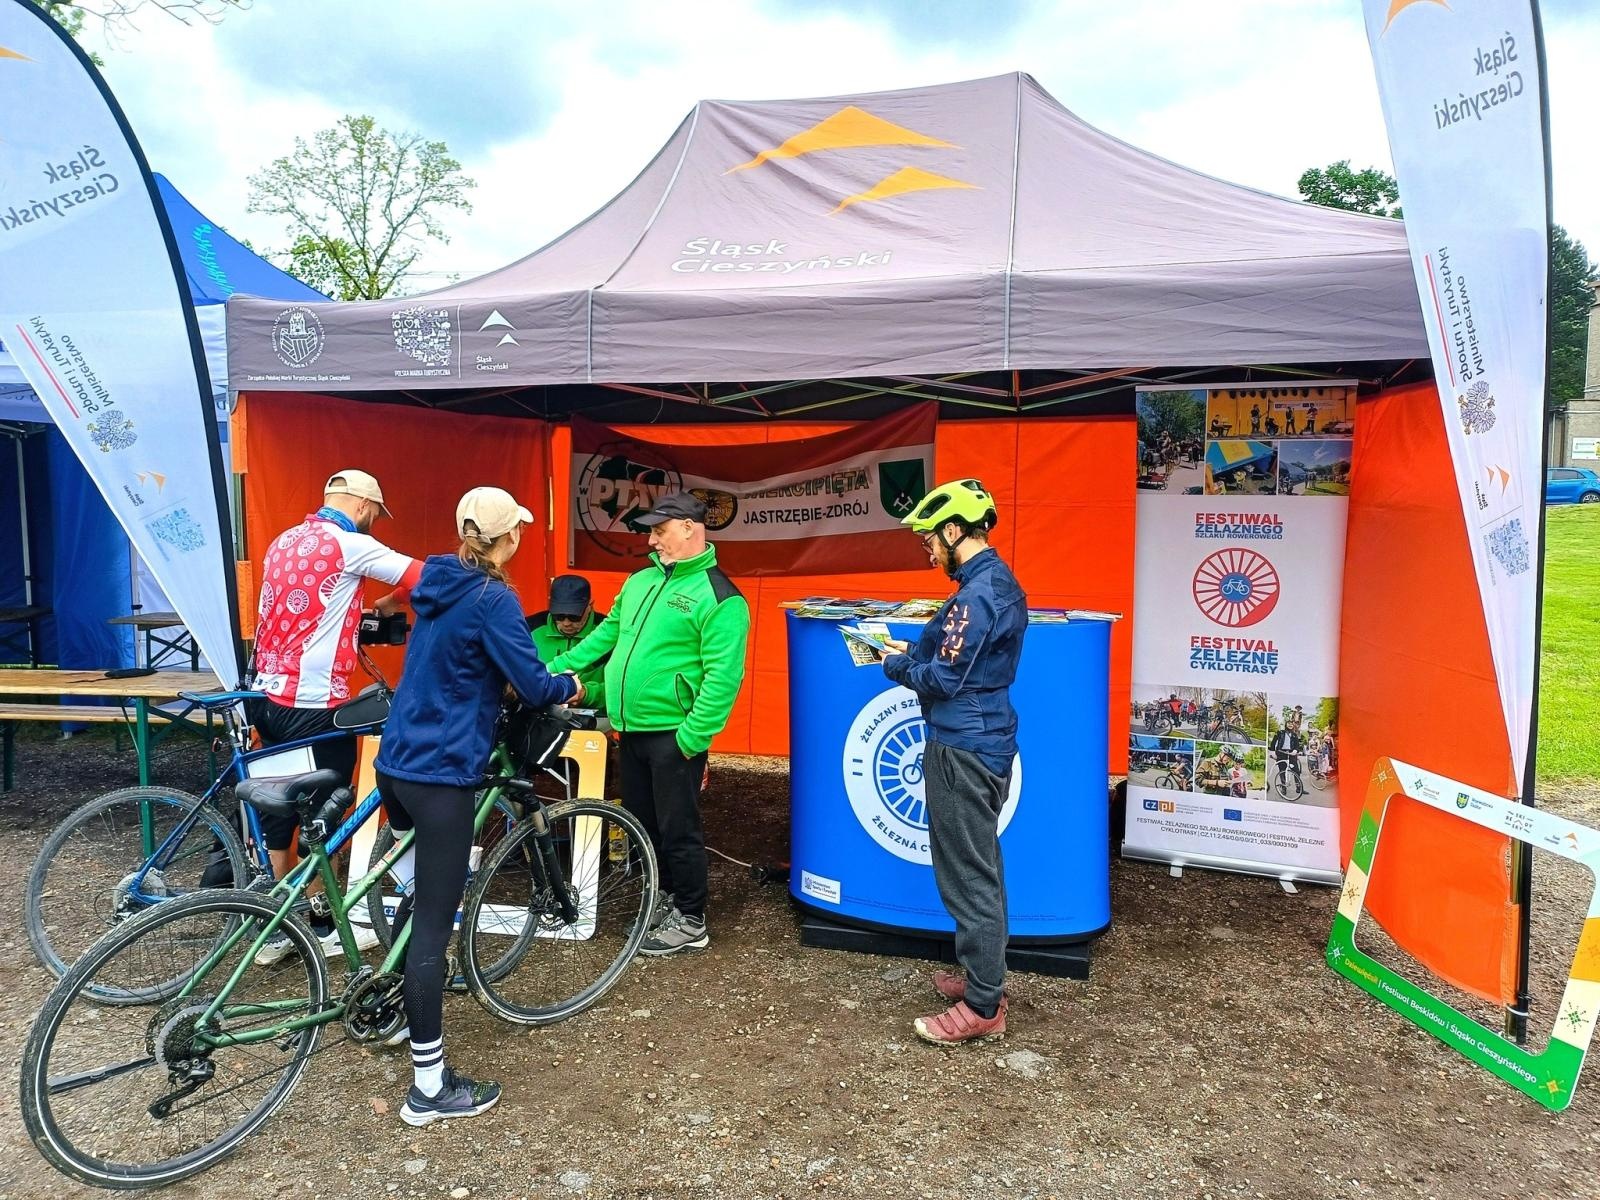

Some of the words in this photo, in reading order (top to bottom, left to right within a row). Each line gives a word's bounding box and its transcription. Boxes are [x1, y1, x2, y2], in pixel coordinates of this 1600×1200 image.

[681, 237, 788, 259] Śląsk
[671, 250, 892, 274] Cieszyński
[476, 355, 493, 363] Śląsk
[743, 499, 869, 525] JASTRZĘBIE-ZDRÓJ
[1195, 513, 1283, 525] FESTIWAL
[1190, 636, 1278, 652] FESTIVAL
[1190, 660, 1278, 674] CYKLOTRASY
[860, 704, 898, 744] ŻELAZNY
[872, 815, 917, 850] ŽELEZNÁ
[1137, 817, 1164, 825] FESTIWAL
[1221, 828, 1266, 838] ROWEROWEGO
[1269, 834, 1296, 842] FESTIVAL
[1160, 826, 1197, 836] CYKLOTRASY
[1381, 982, 1410, 1004] Festiwal
[1410, 999, 1445, 1026] Beskidów
[1450, 1023, 1476, 1047] Śląska
[1477, 1042, 1537, 1085] Cieszyńskiego
